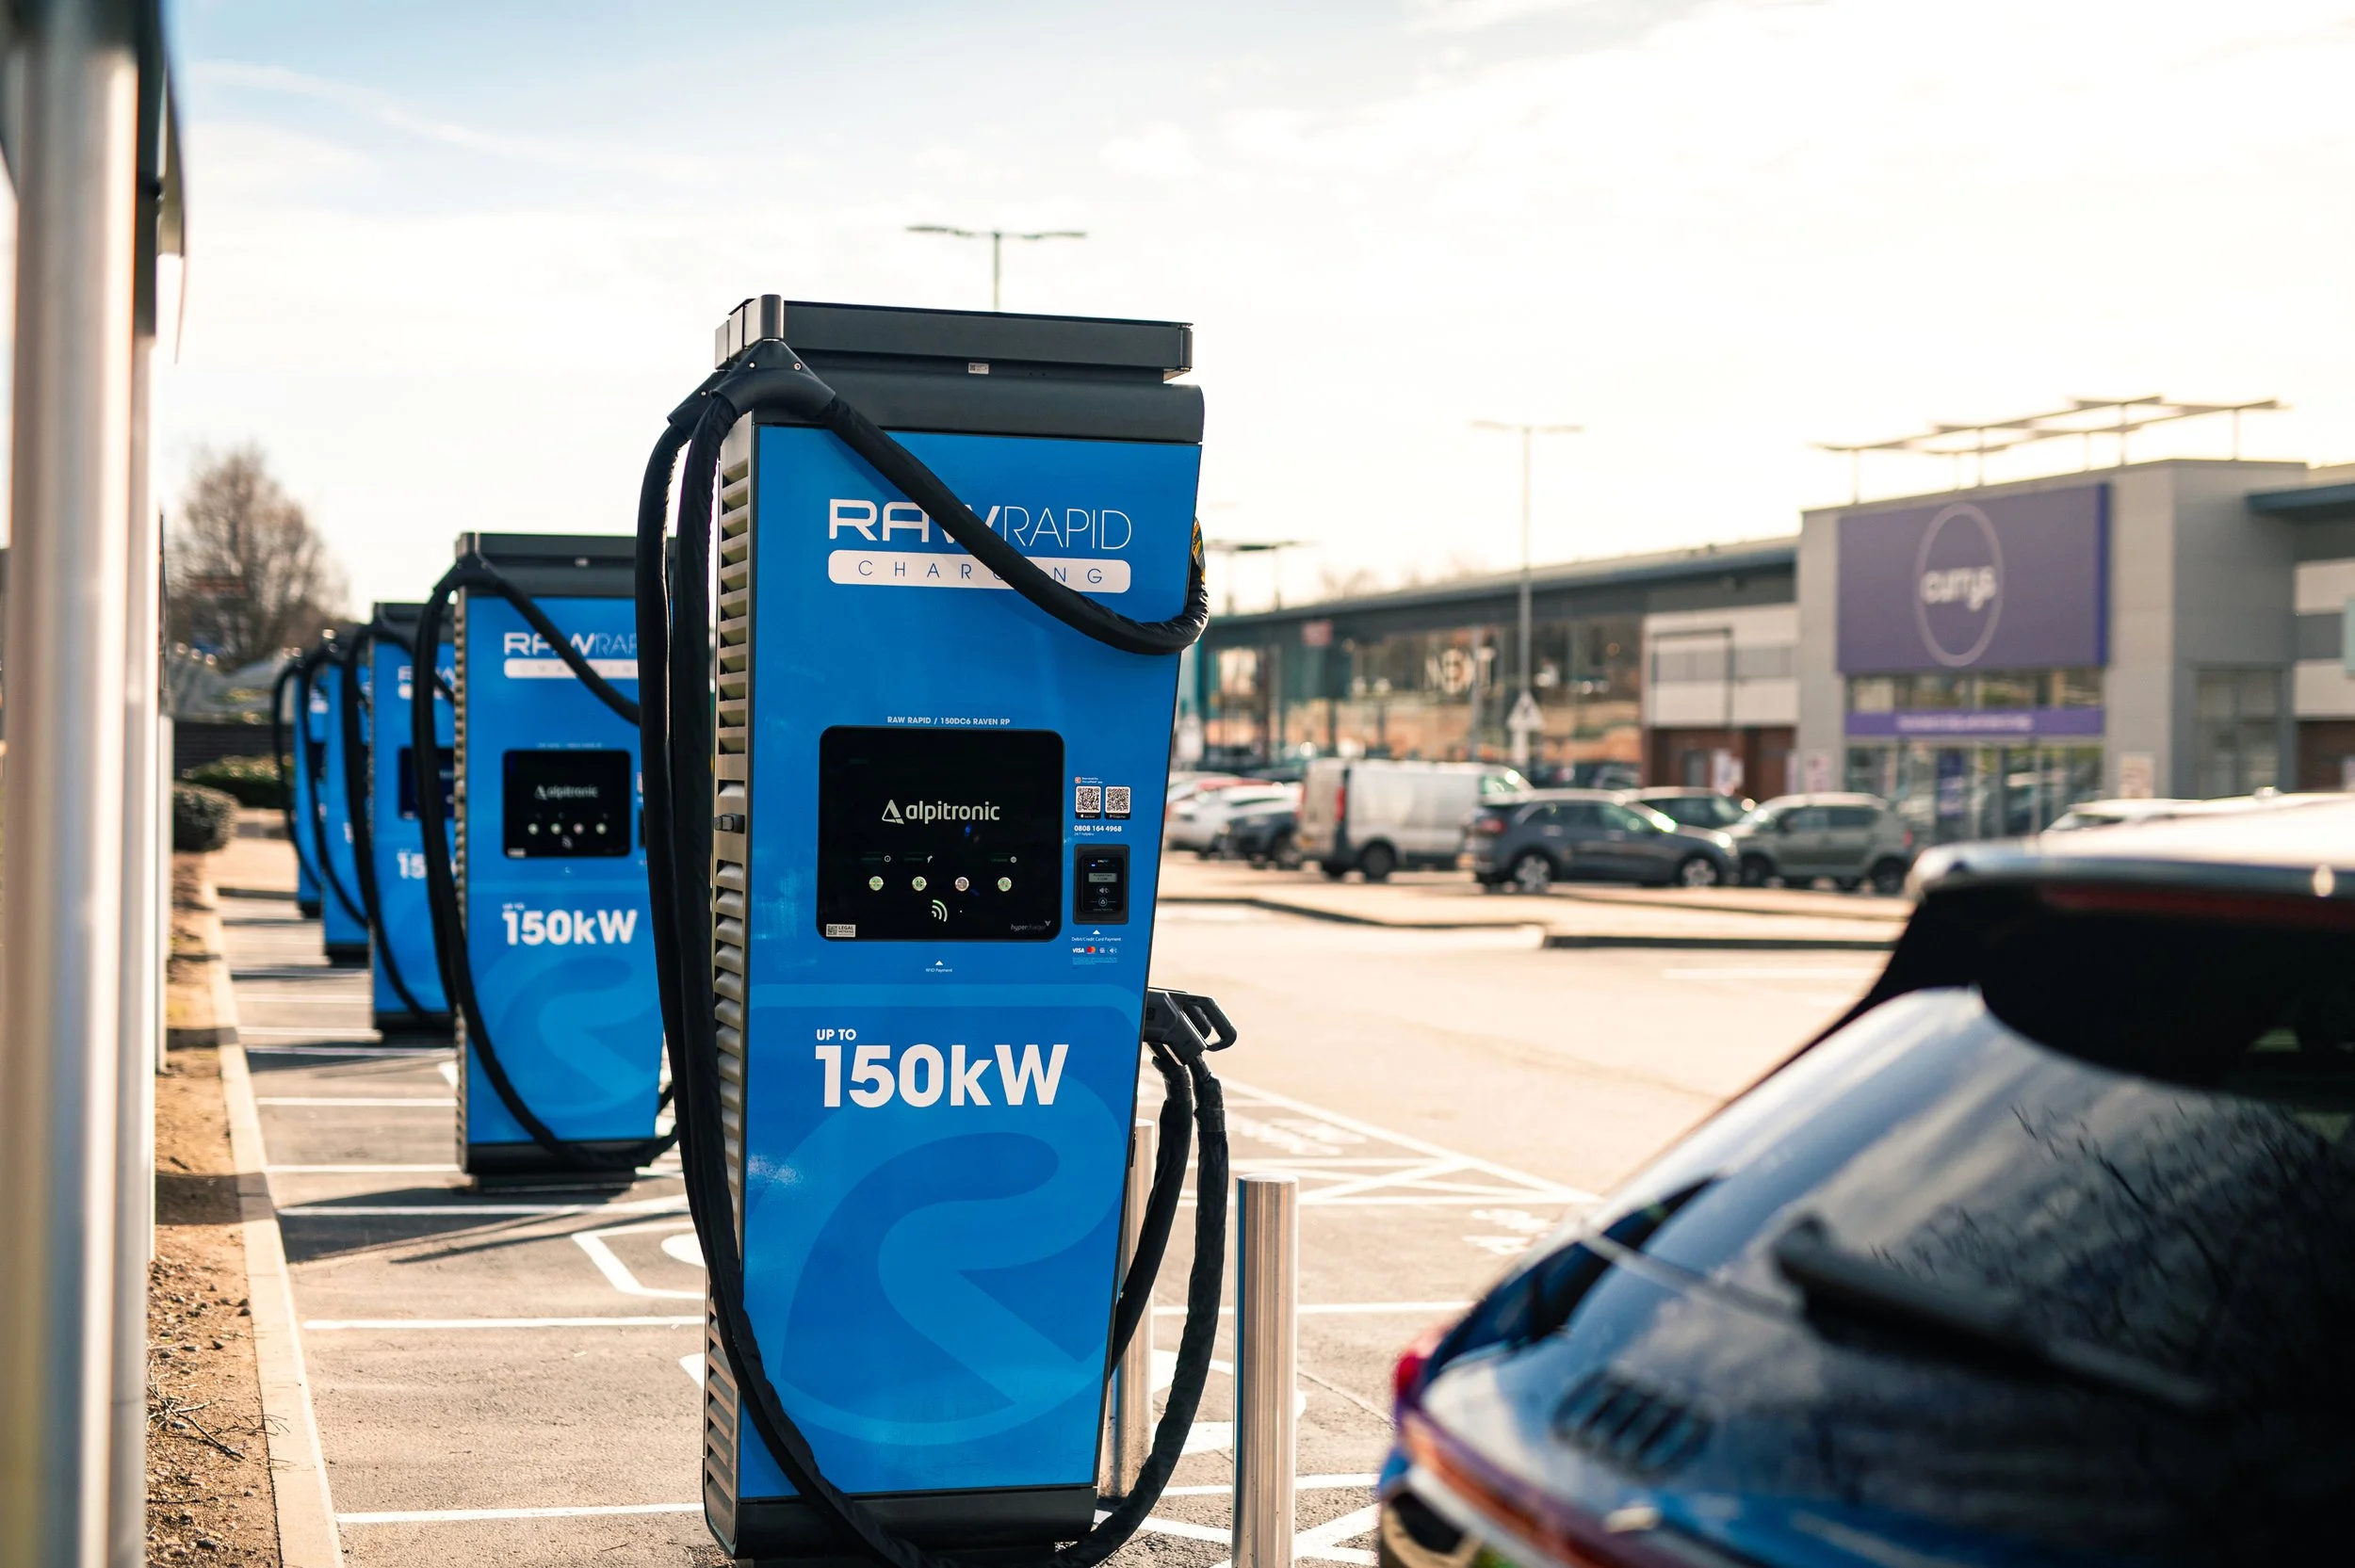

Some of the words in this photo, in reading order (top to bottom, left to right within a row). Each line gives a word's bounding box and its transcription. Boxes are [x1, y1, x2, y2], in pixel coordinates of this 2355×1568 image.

[858, 559, 1102, 584] CHARNG
[940, 717, 971, 725] 150DC6
[905, 800, 999, 824] alpitronic
[502, 909, 638, 946] 150kW
[816, 1028, 835, 1041] UP
[838, 1028, 856, 1041] TO
[816, 1043, 1069, 1107] 150kW
